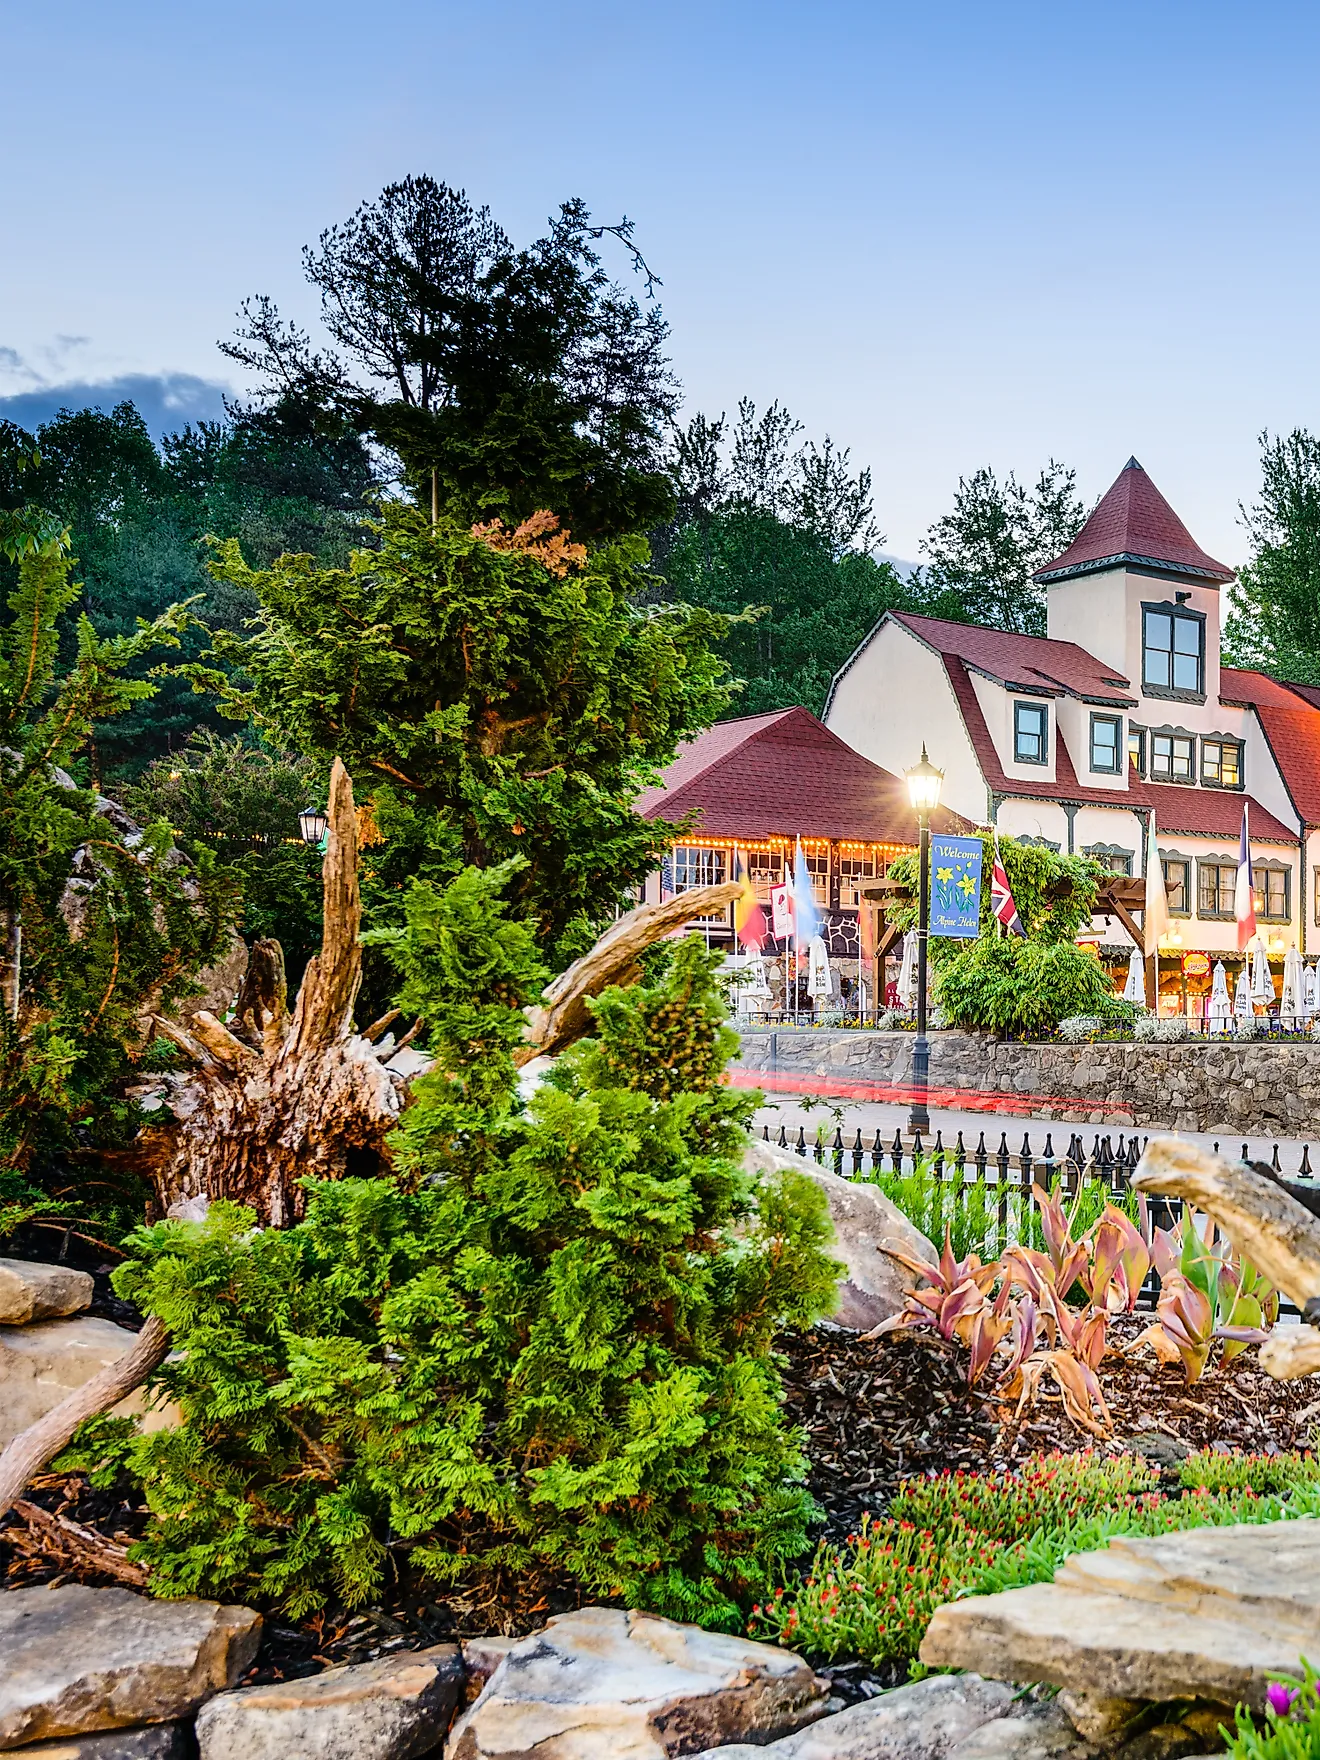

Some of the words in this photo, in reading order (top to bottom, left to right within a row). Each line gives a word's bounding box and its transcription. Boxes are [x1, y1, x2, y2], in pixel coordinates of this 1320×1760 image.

[934, 845, 980, 860] Welcome
[933, 914, 957, 929] Alpine
[957, 915, 977, 928] Helen
